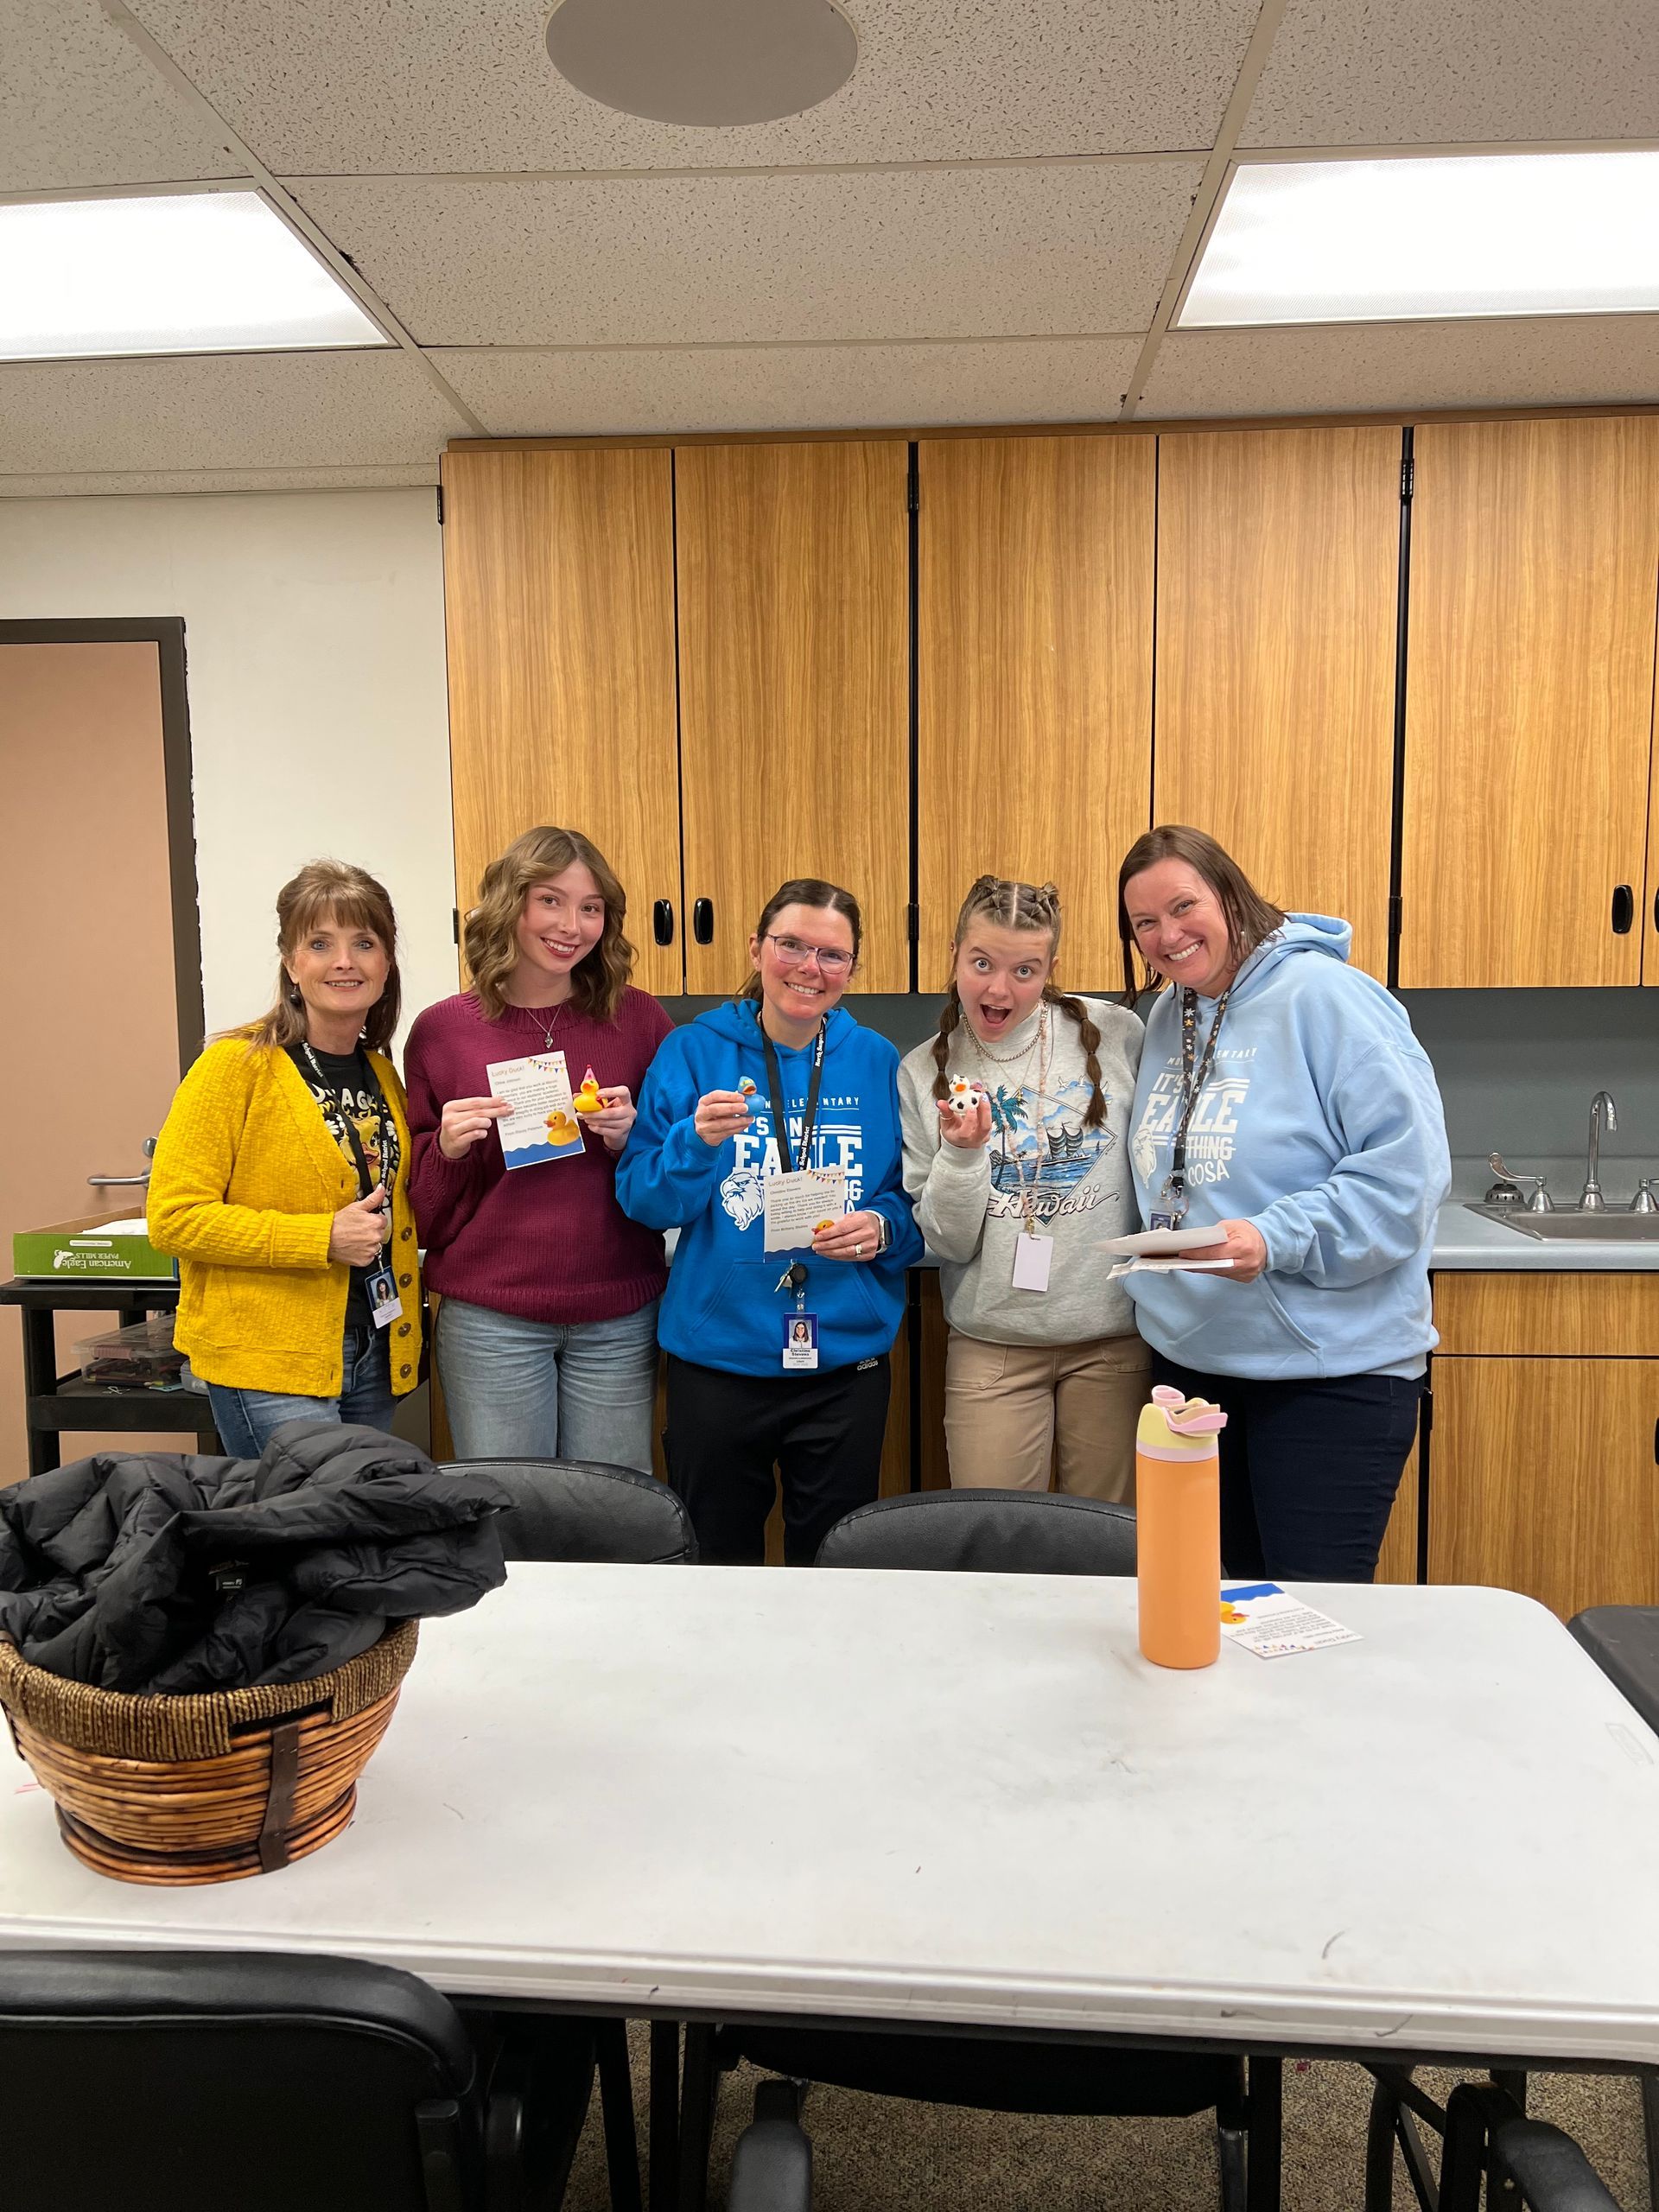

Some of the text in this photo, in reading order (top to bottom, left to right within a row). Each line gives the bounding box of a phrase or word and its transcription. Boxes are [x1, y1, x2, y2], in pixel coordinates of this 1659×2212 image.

[1139, 1090, 1247, 1134] EALE
[802, 1126, 810, 1147] District
[798, 1147, 807, 1166] School
[1186, 1136, 1234, 1160] THING
[1188, 1160, 1230, 1187] COSA
[62, 1257, 131, 1269] American Eagle
[856, 1359, 879, 1371] adidas
